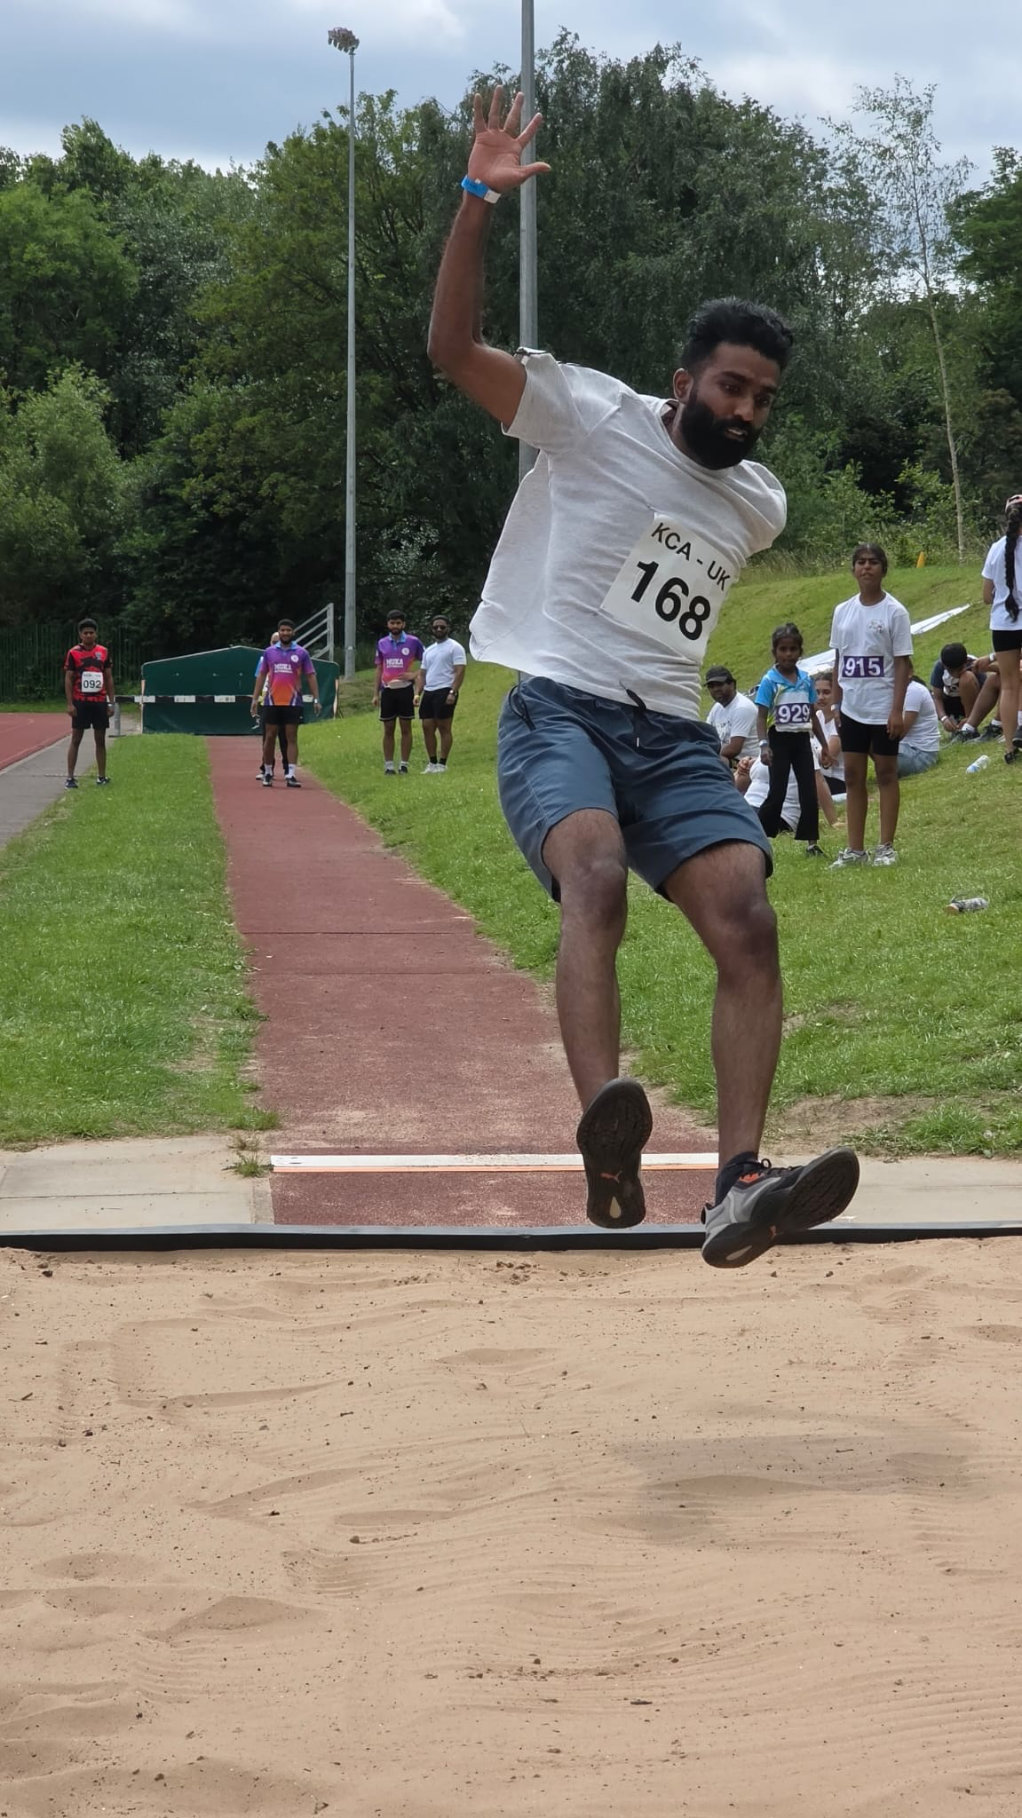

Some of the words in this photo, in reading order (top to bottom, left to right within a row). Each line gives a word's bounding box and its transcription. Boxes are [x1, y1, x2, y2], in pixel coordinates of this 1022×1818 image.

[651, 522, 692, 561] KCA
[707, 560, 731, 592] UK
[630, 560, 711, 641] 168
[844, 657, 881, 677] 915
[83, 679, 102, 689] 092
[778, 703, 810, 724] 929
